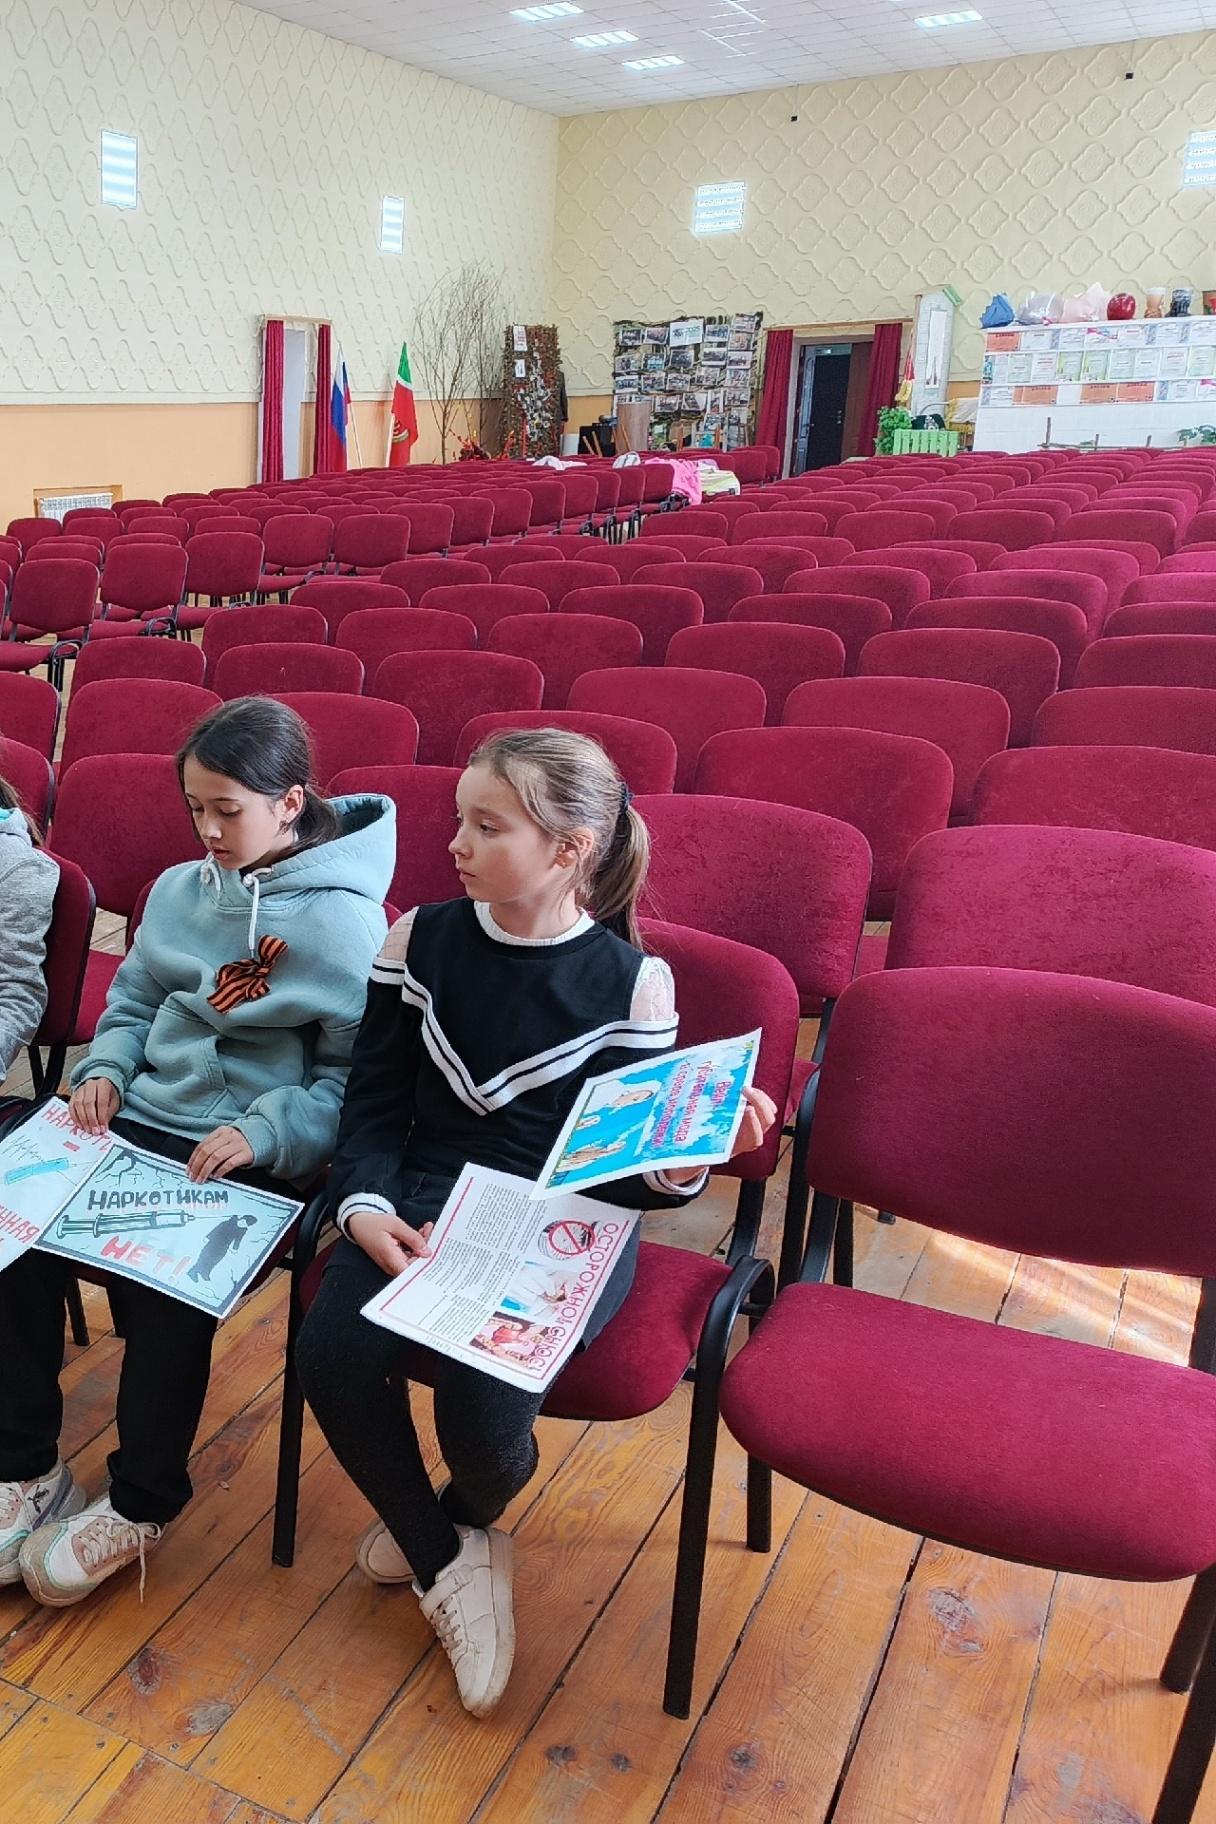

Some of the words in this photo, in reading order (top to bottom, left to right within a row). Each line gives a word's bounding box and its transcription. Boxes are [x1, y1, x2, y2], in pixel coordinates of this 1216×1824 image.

[675, 1116, 693, 1142] мода
[88, 1189, 229, 1211] НАРКОТИКАМ
[100, 1235, 192, 1281] НЕТ!
[555, 1222, 619, 1325] ОСТОРОЖНО!
